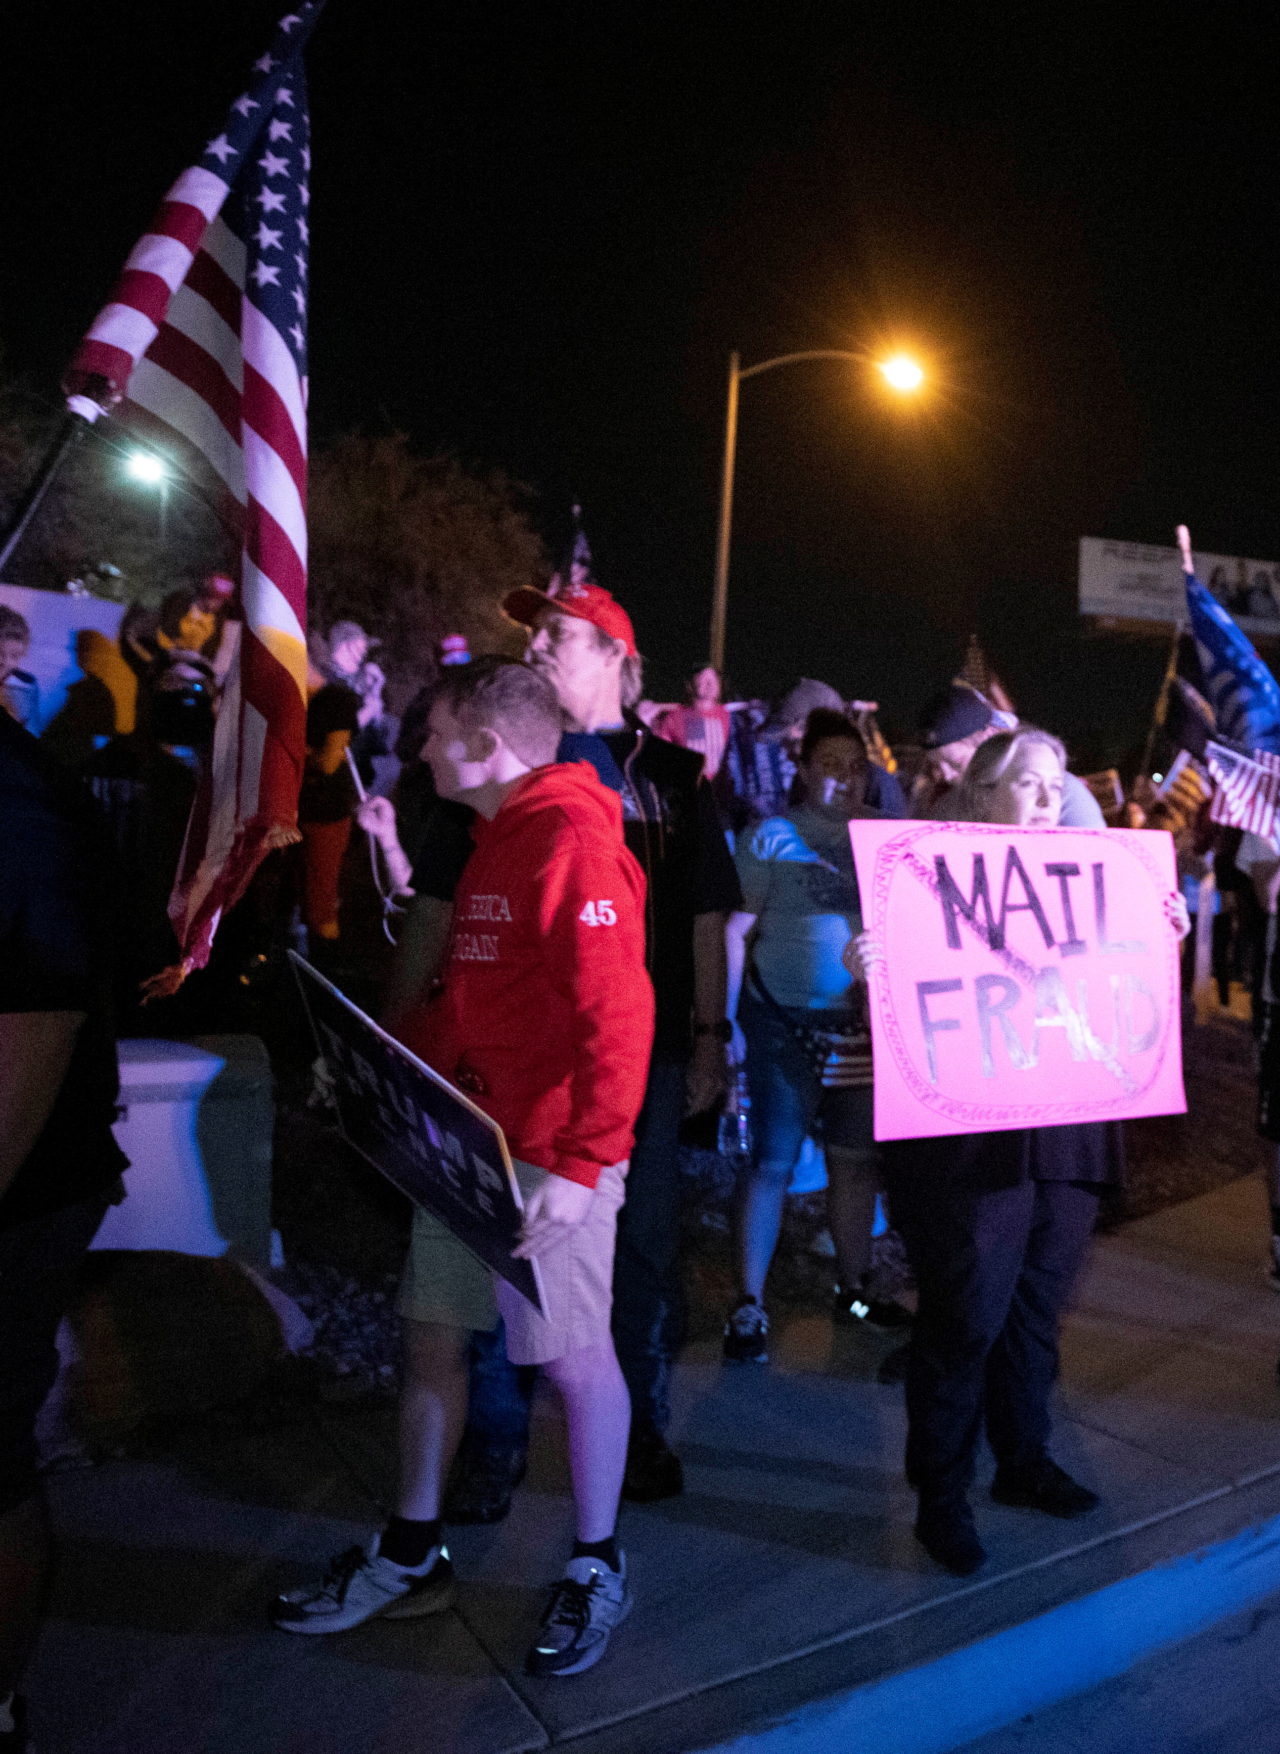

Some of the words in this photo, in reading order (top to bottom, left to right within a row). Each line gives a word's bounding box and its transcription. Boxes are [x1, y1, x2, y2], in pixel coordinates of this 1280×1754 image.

[579, 900, 617, 927] 45
[934, 845, 1147, 957] MAIL
[916, 967, 1161, 1085] FRAUD
[317, 1017, 505, 1193] TRUMP
